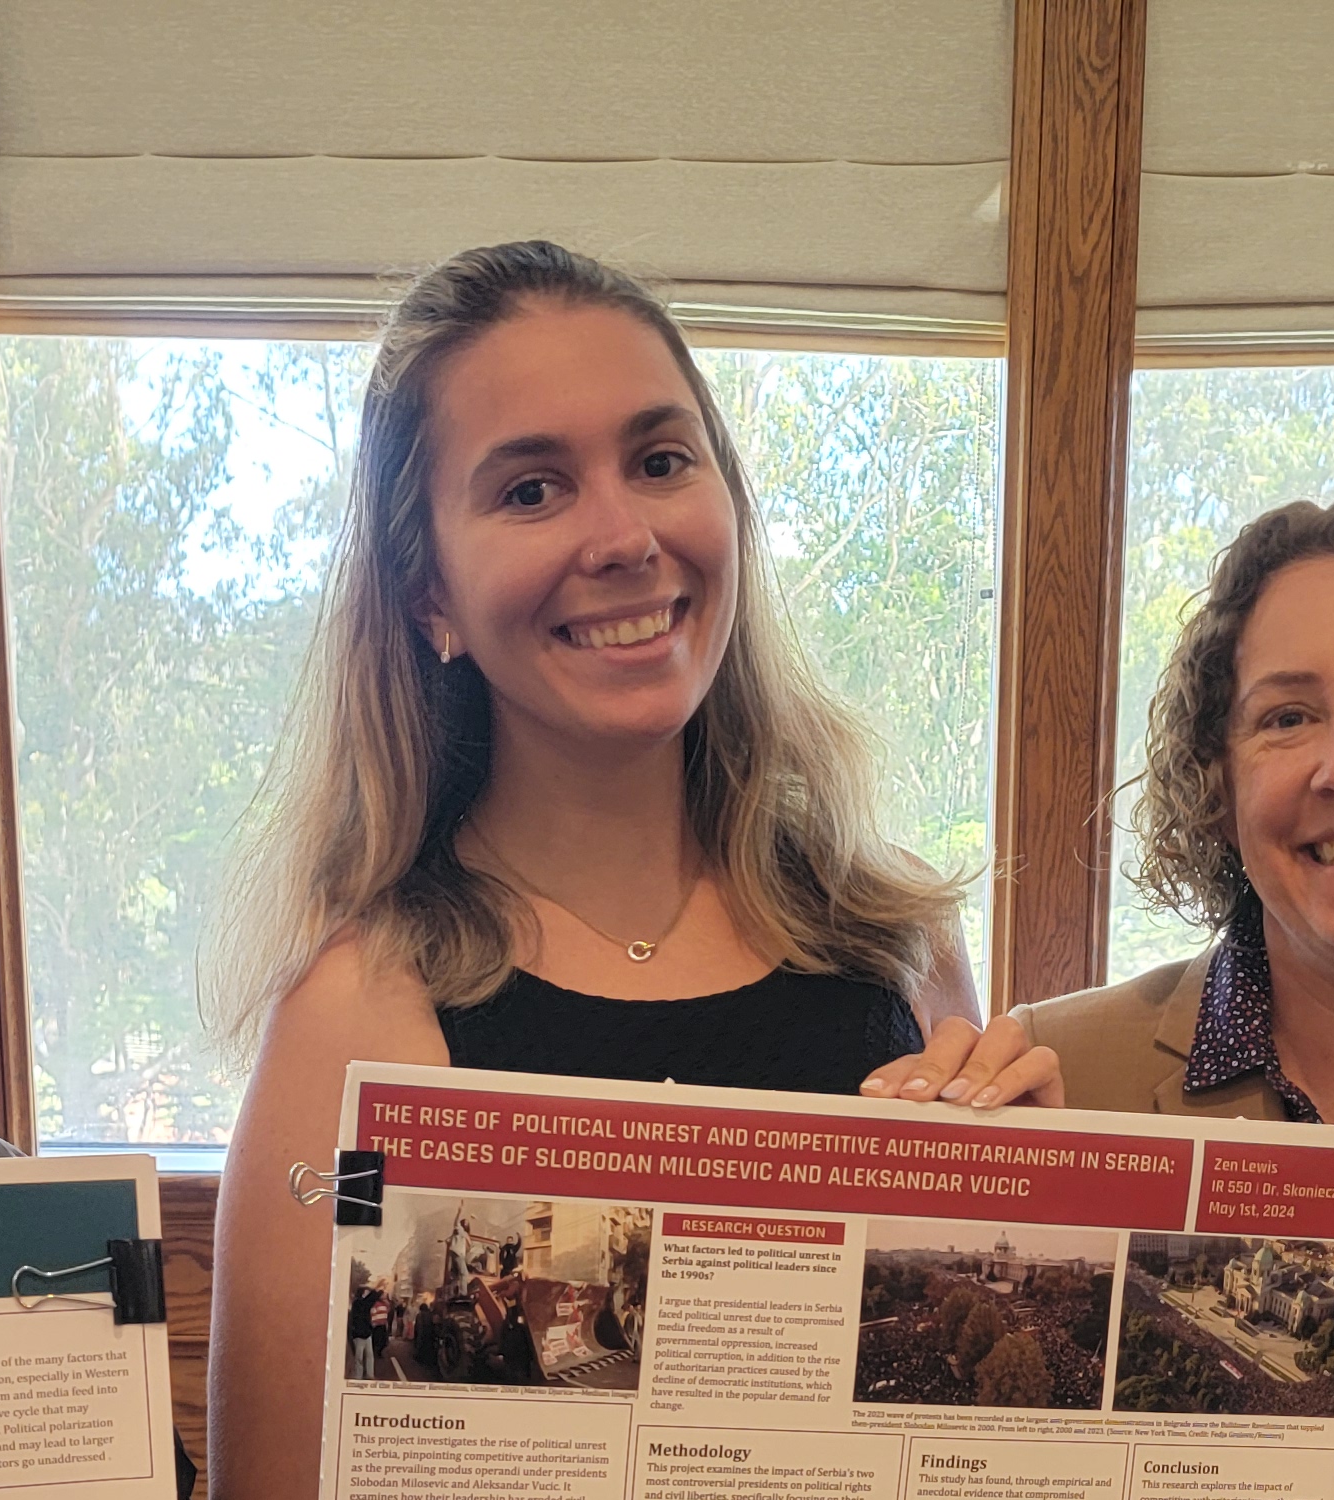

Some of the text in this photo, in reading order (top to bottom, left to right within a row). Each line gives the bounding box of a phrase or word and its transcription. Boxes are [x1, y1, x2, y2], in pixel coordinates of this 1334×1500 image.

[372, 1103, 1174, 1173] THE RISE OF POLITICAL UNREST AND COMPETITIVE AUTHORITARIANISM IN SERBIA:
[371, 1136, 1030, 1195] THE CASES OF SLOBODAN MILOSEVIC AND ALEKSANDAR VUCIC
[1213, 1157, 1277, 1173] Zen Lewis
[1211, 1179, 1224, 1192] IR
[1227, 1180, 1252, 1193] 550
[1262, 1182, 1278, 1195] Dr.
[1208, 1201, 1294, 1217] May 1st, 2024
[682, 1219, 825, 1237] RESEARCH QUESTION
[663, 1242, 841, 1260] What factors led to political unrest in
[354, 1412, 465, 1429] Introduction
[648, 1443, 751, 1462] Methodology
[921, 1454, 987, 1472] Findings
[1144, 1461, 1218, 1474] Conclusion
